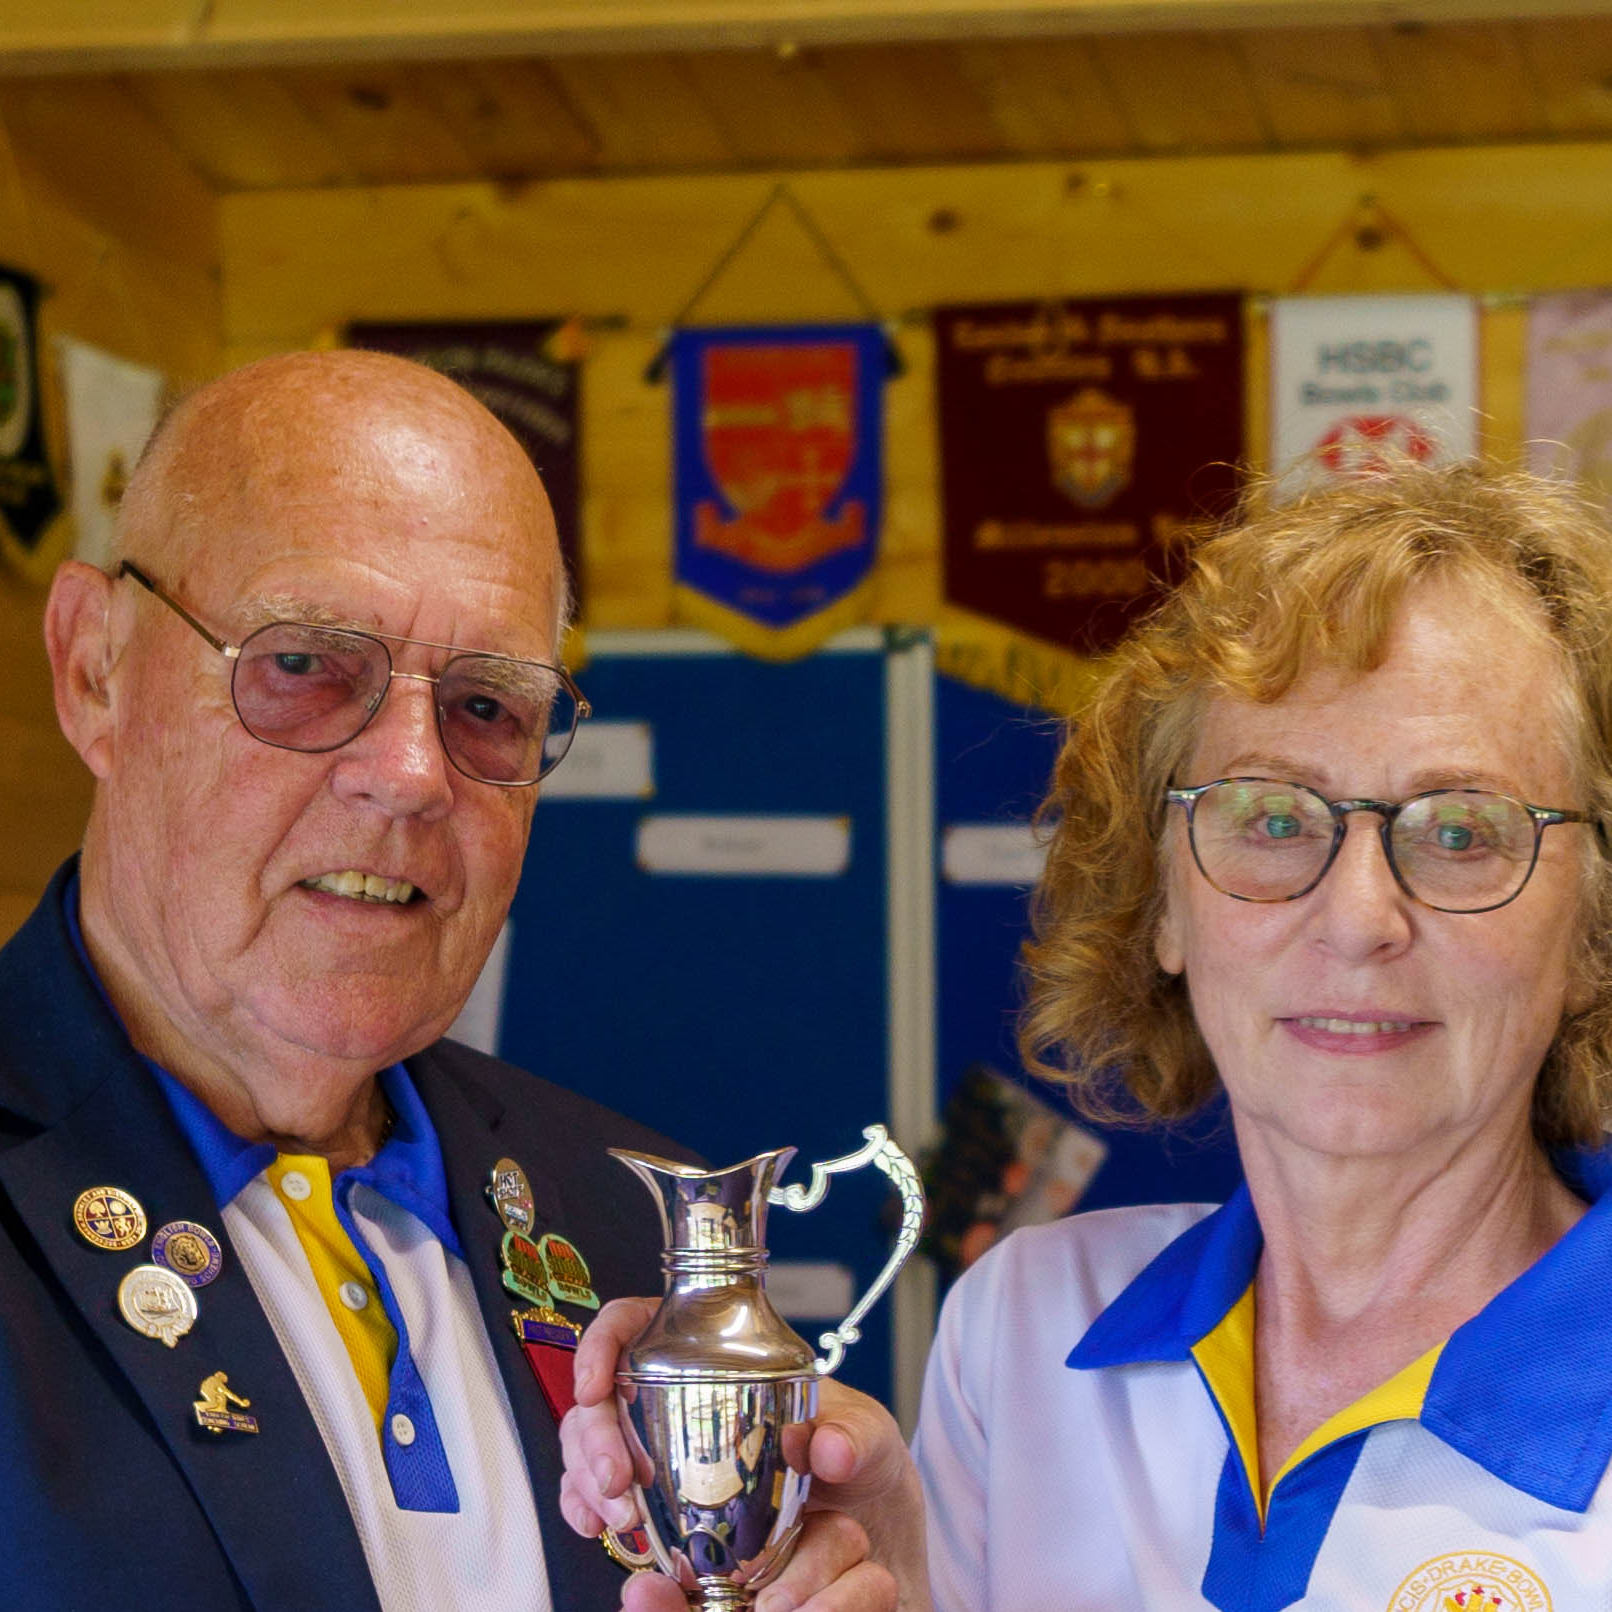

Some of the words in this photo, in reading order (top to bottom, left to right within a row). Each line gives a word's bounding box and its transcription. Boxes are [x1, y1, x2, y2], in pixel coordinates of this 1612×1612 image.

[1319, 339, 1431, 373] HSBC
[155, 1224, 184, 1248] ENGLISH
[1426, 1557, 1504, 1582] DRAKE
